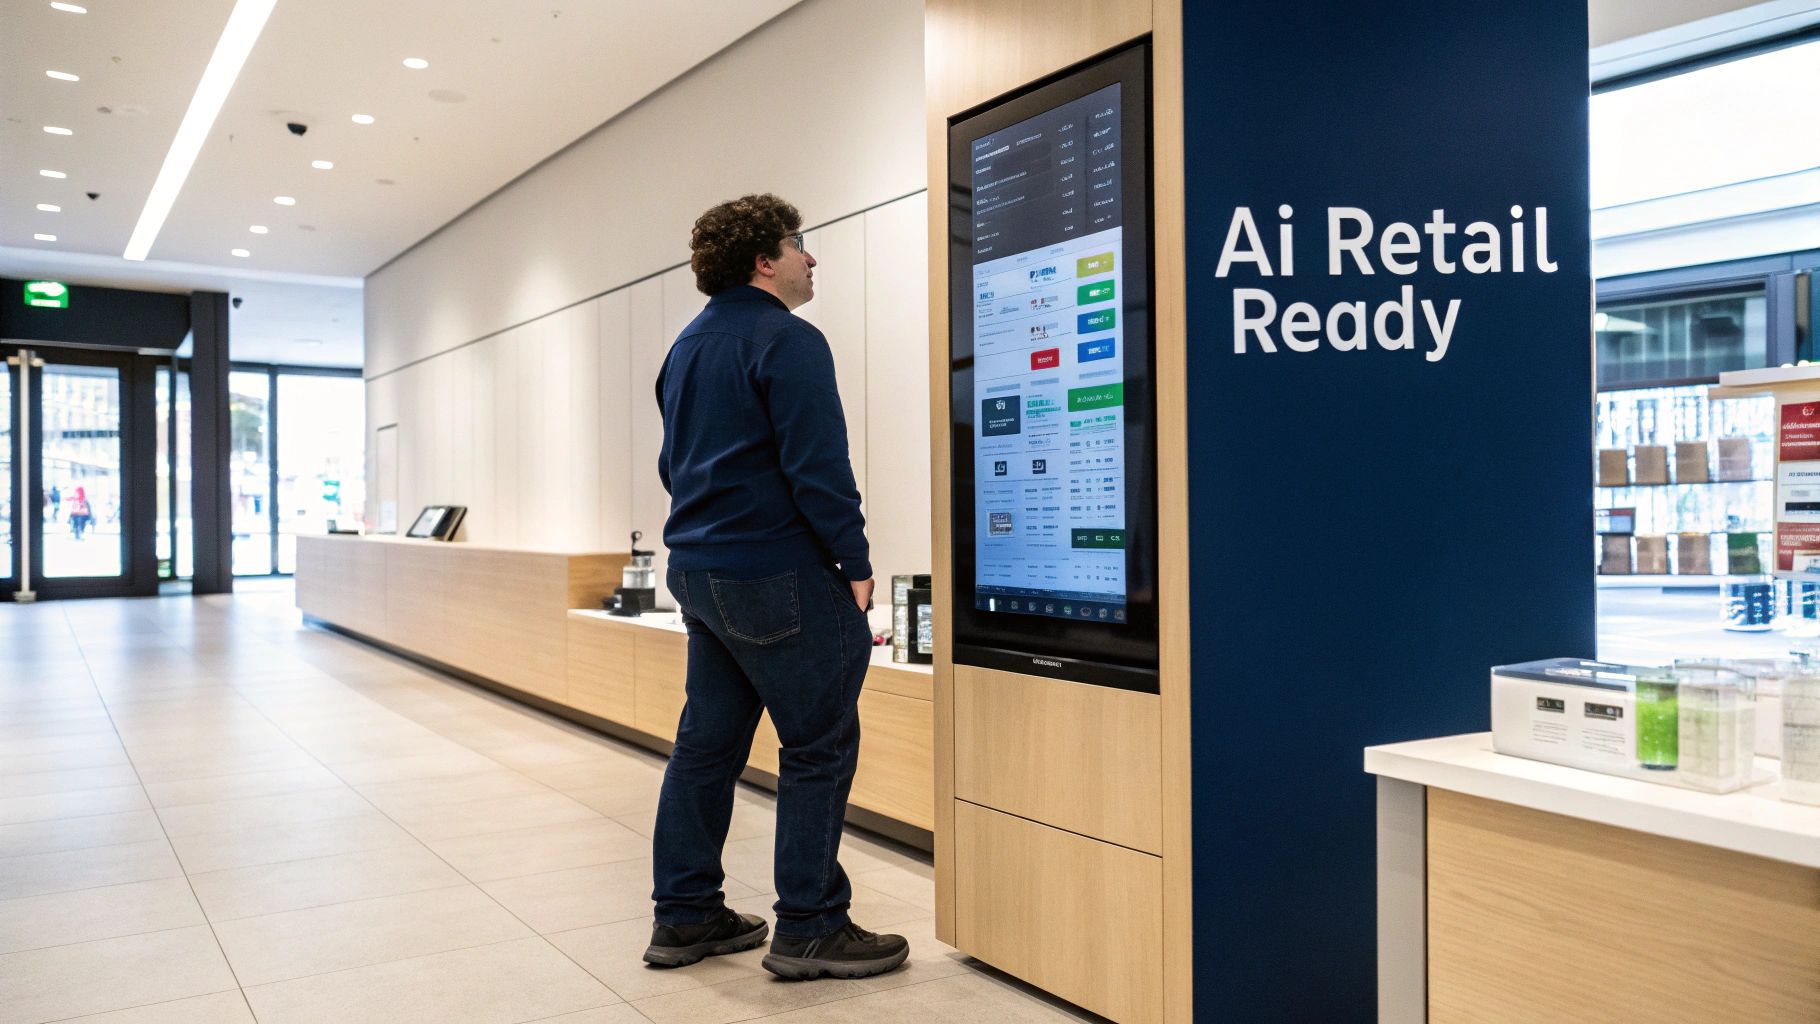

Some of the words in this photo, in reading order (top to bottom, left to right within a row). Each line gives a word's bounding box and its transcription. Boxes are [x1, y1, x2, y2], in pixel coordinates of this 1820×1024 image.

[1214, 203, 1294, 278] Ai
[1327, 204, 1559, 276] Retail
[1232, 284, 1462, 363] Ready
